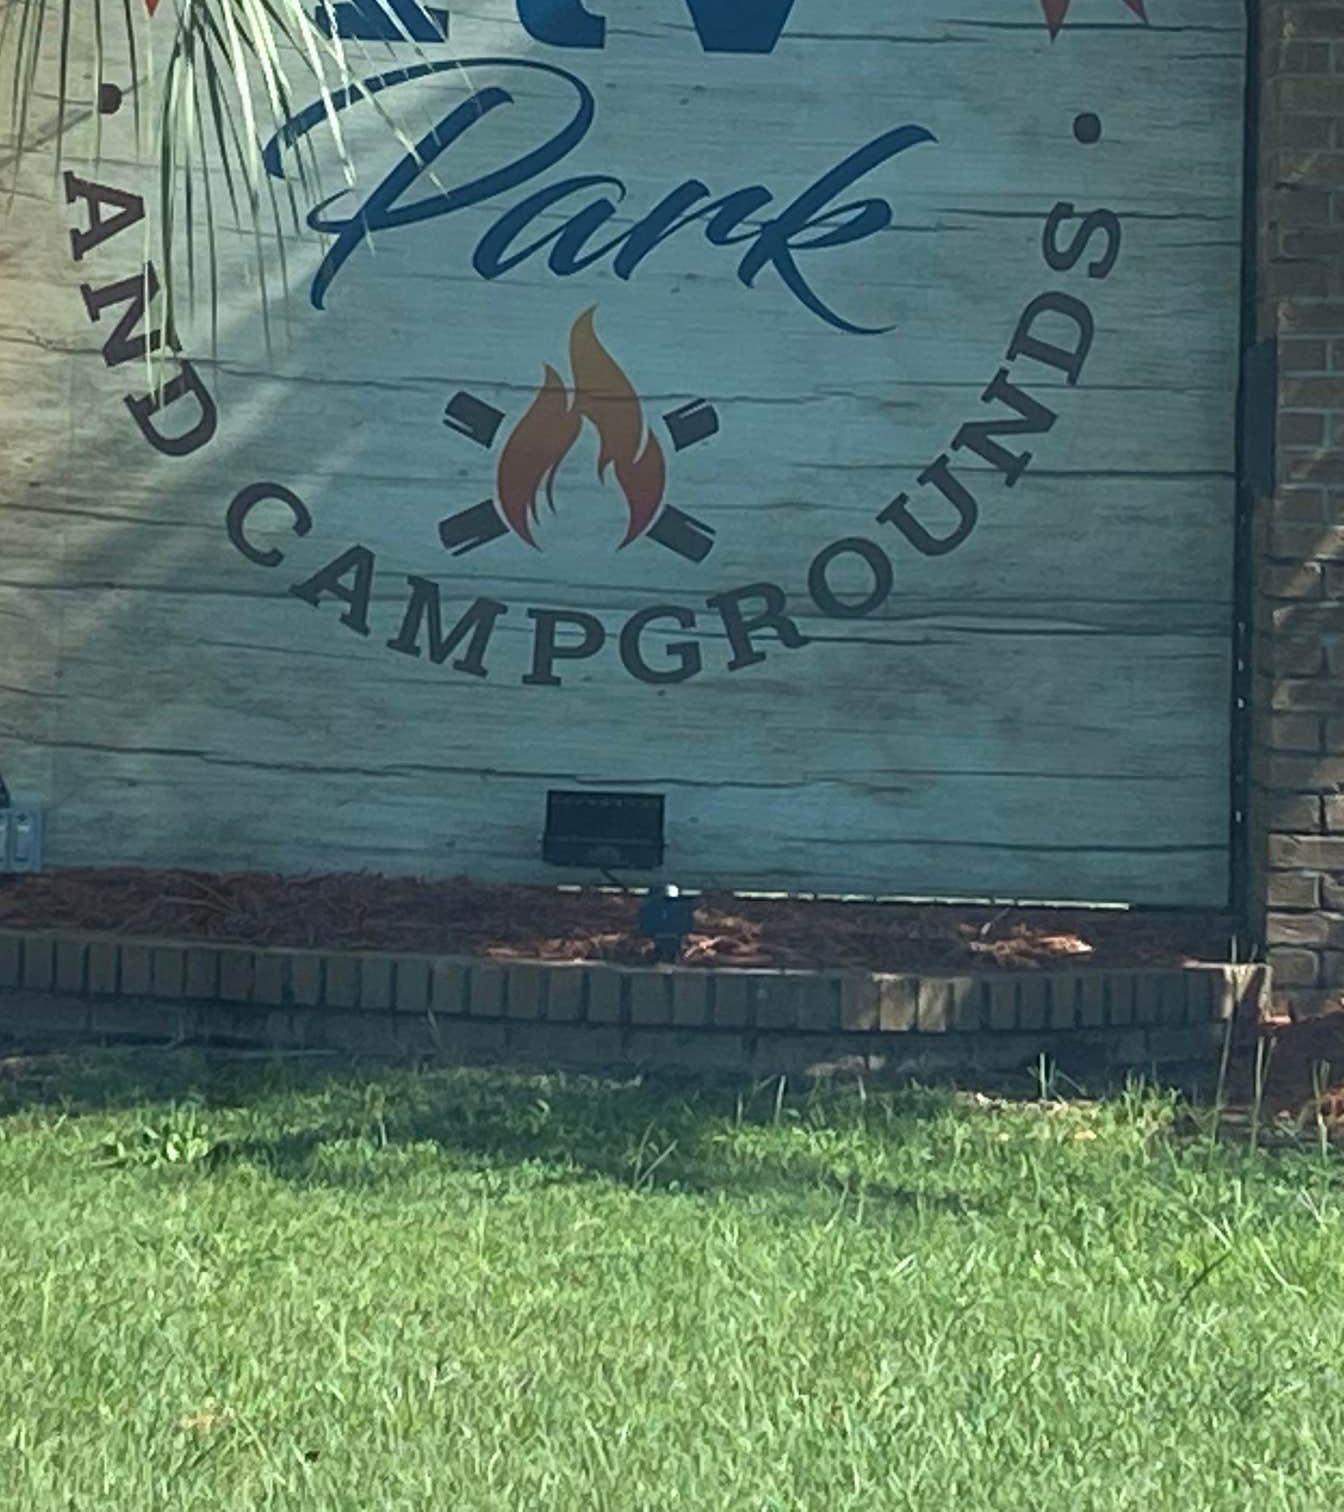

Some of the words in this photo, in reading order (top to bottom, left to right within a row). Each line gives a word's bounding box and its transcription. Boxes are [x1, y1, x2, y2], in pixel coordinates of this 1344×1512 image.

[264, 57, 938, 335] Park
[62, 170, 220, 458] AND
[224, 199, 1123, 687] CAMPGROUNDS
